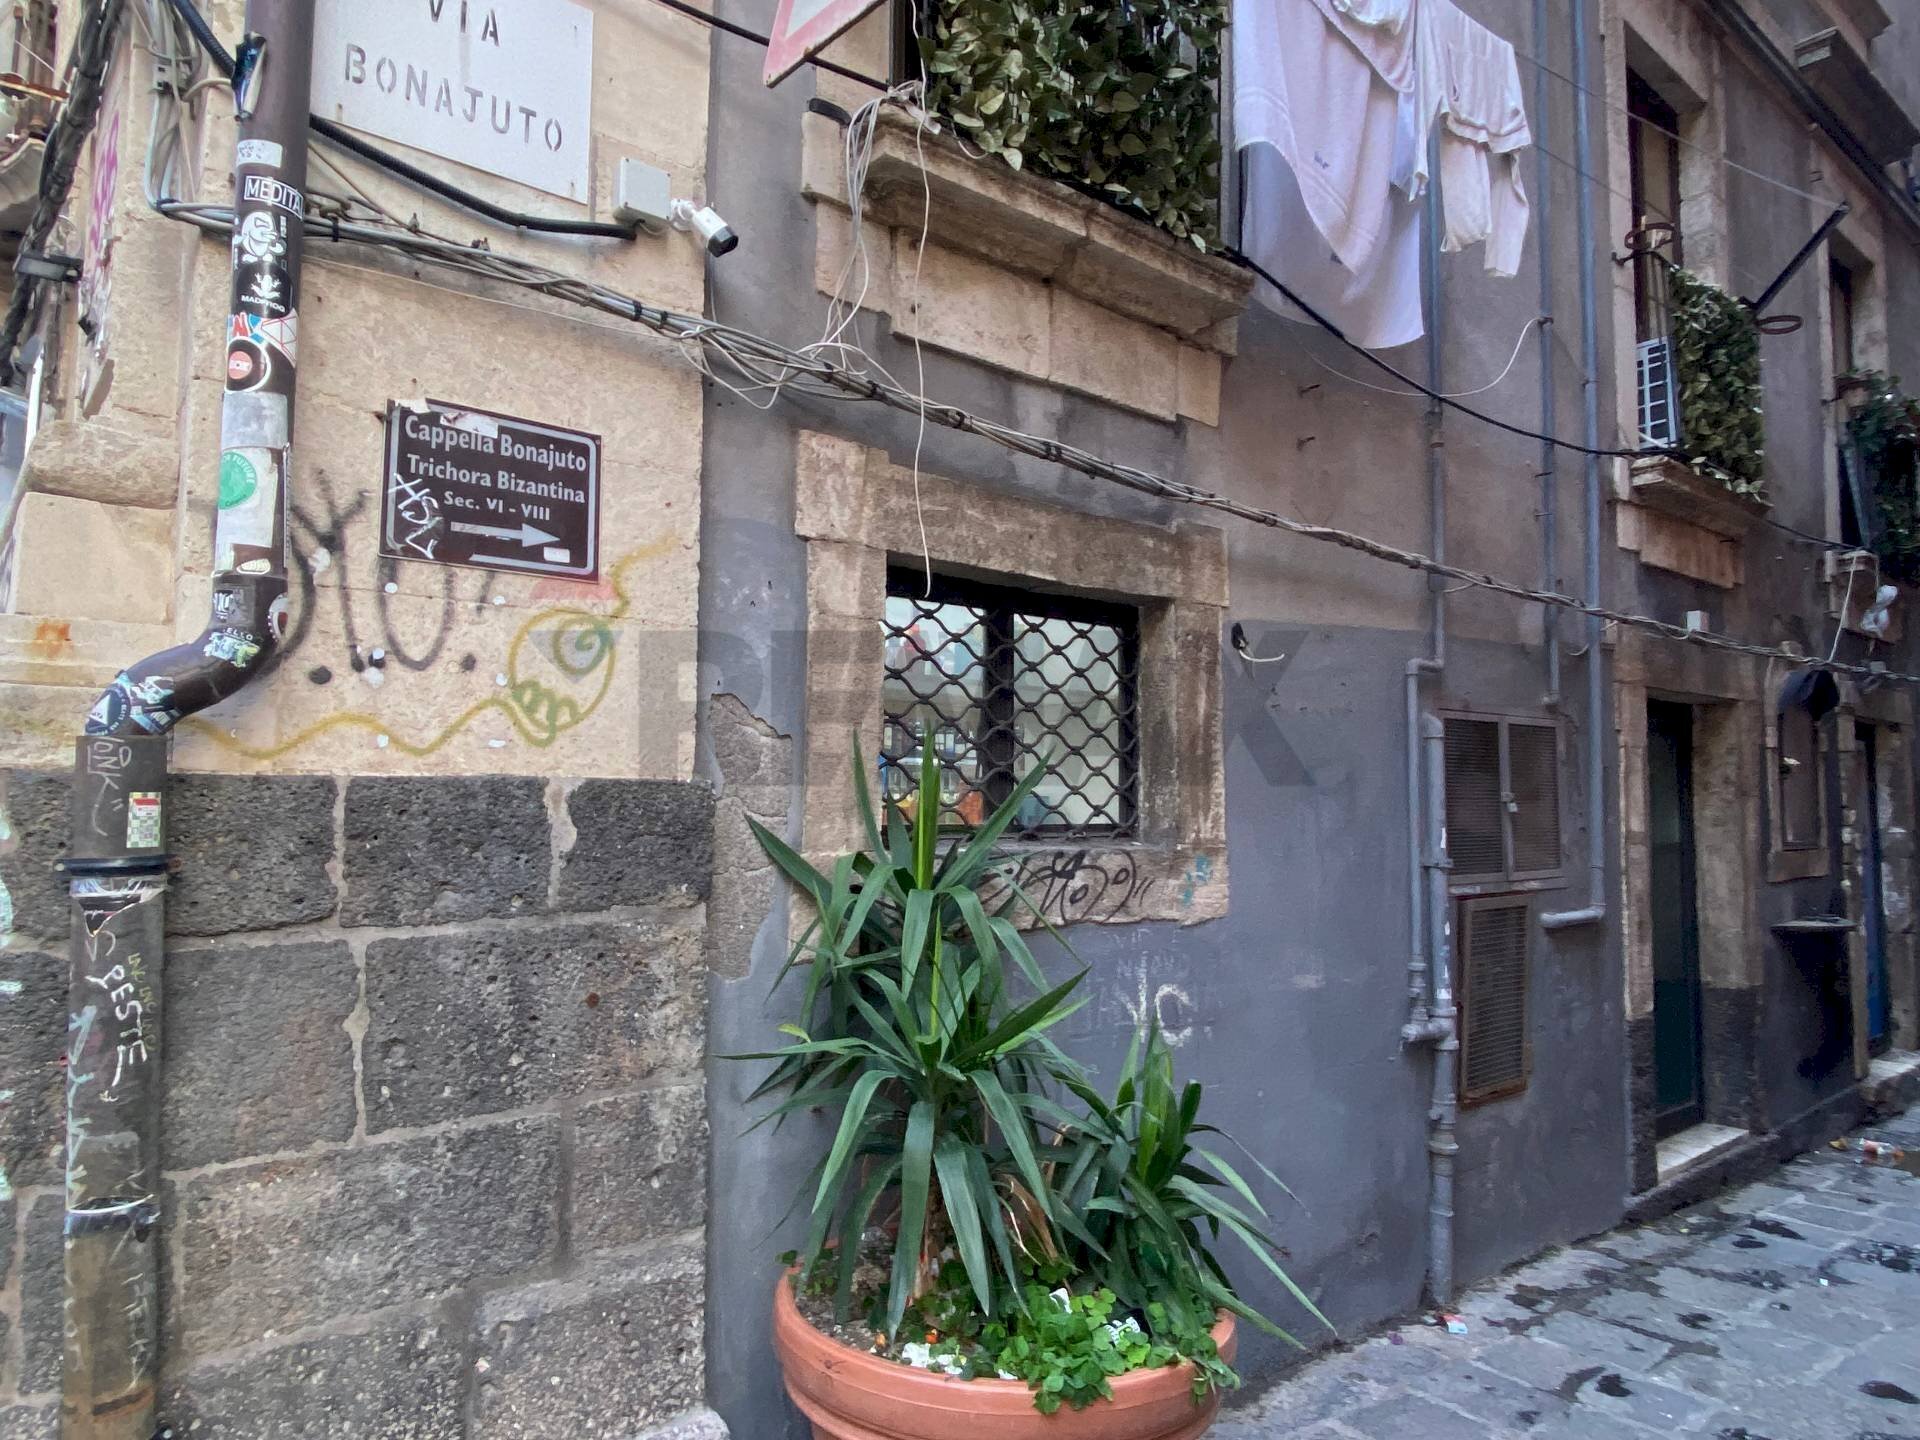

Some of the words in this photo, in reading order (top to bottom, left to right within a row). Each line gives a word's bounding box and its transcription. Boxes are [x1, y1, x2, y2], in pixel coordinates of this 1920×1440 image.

[429, 0, 500, 46] VIA
[345, 43, 562, 151] BONAJUTO
[405, 415, 495, 453] Cappella
[500, 434, 587, 471] Bonajuto
[407, 453, 491, 487] Trichora
[497, 470, 585, 504] Bizantina
[444, 491, 480, 510] Sec.
[487, 498, 503, 514] VI
[521, 503, 550, 521] VIII
